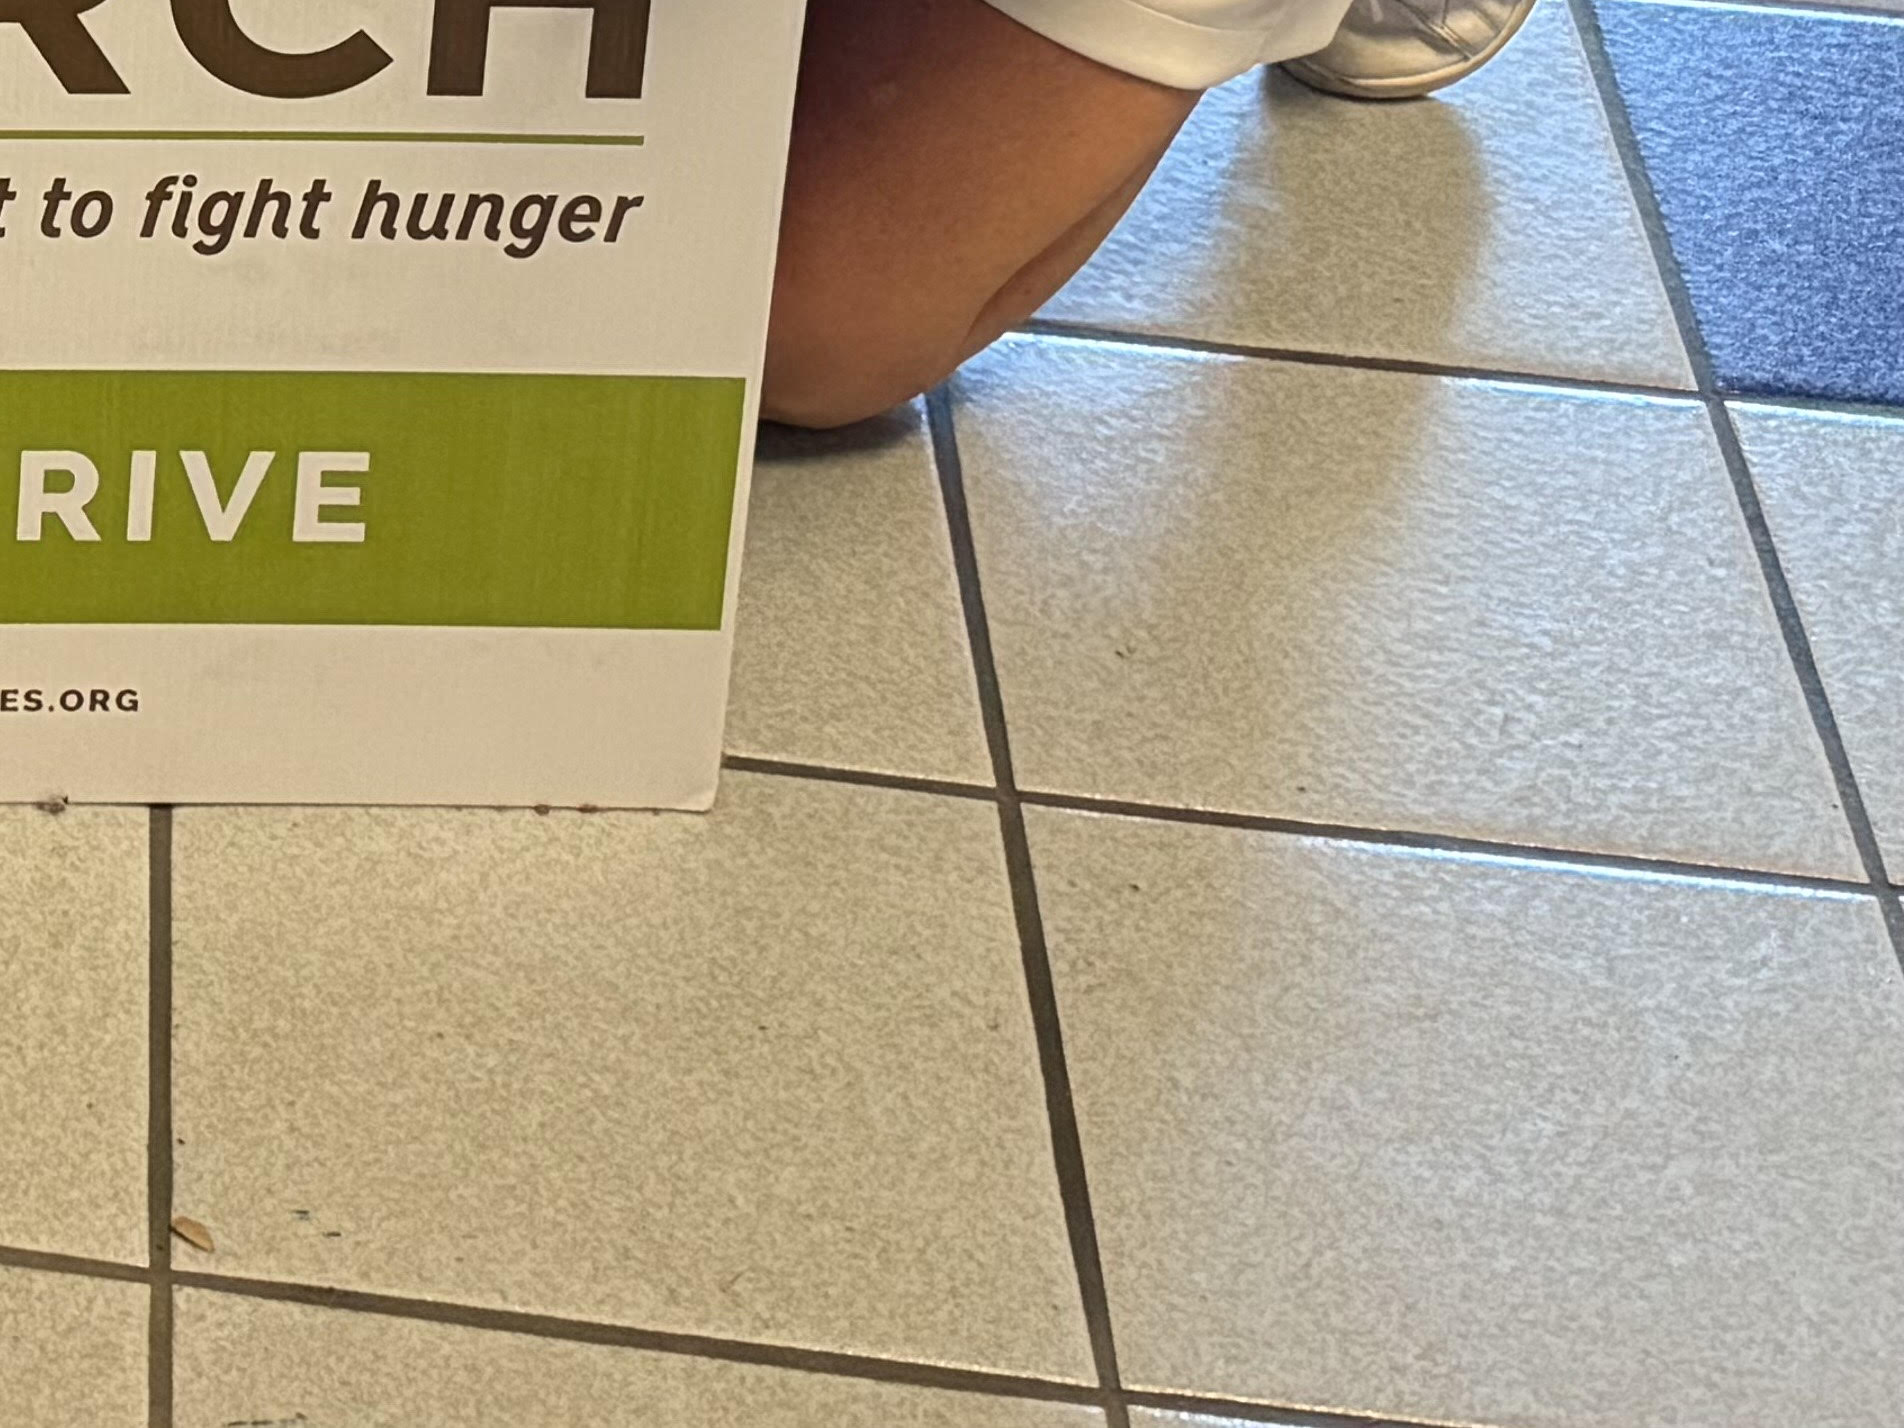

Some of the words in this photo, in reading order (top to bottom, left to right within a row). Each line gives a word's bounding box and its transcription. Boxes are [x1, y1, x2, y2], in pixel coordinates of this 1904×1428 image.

[39, 177, 114, 239] to
[136, 175, 332, 256] fight
[350, 179, 645, 259] hunger
